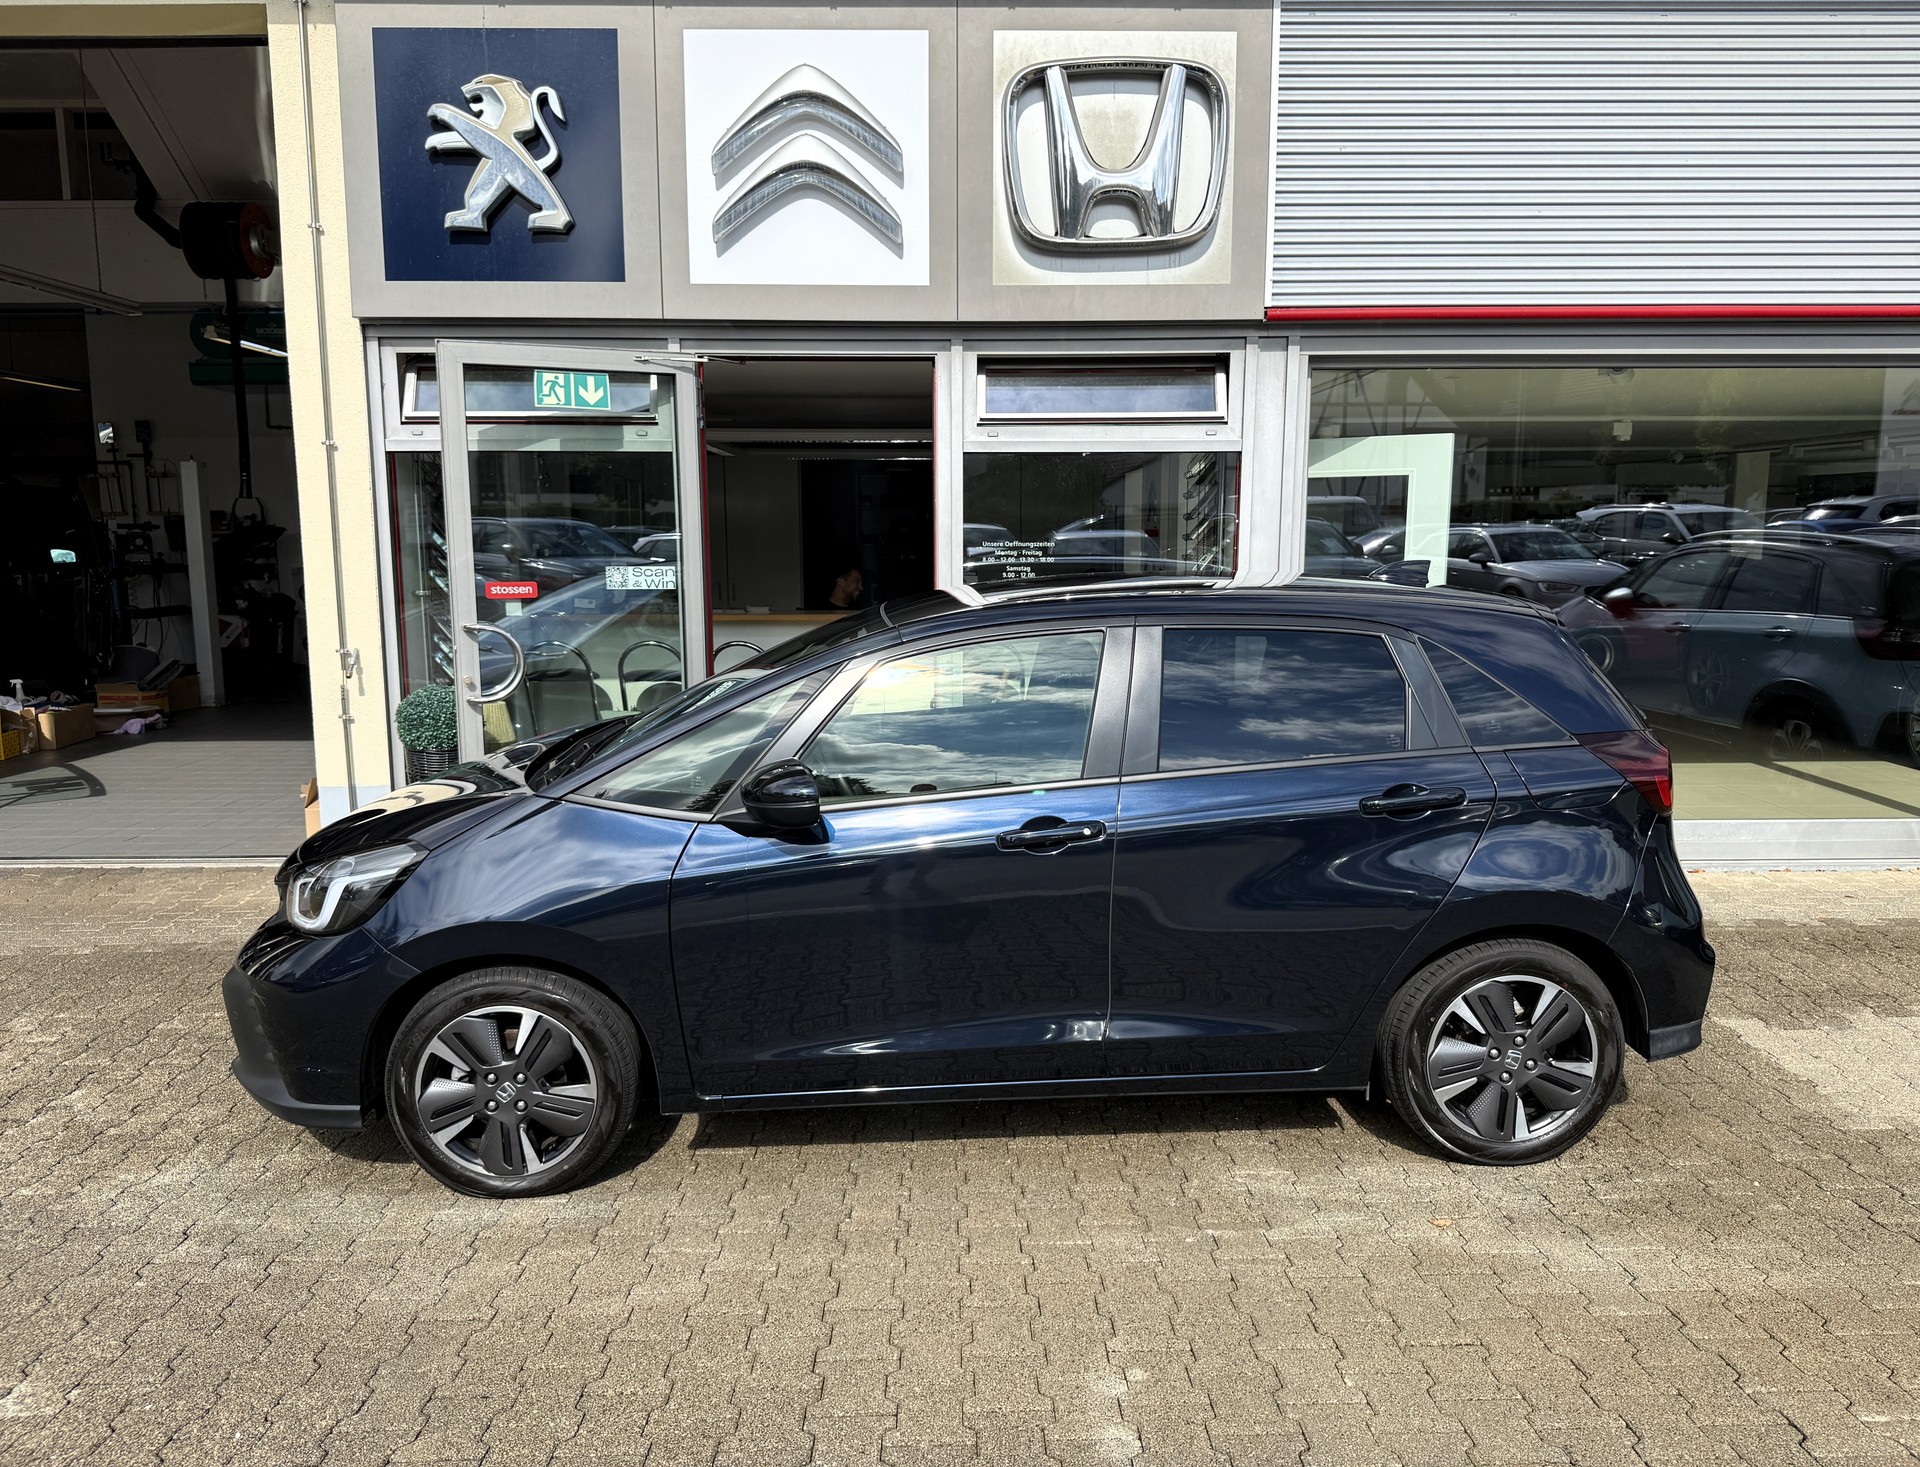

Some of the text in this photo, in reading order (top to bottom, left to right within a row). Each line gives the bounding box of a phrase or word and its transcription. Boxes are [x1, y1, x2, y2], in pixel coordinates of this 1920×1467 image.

[632, 567, 675, 577] Scan
[632, 578, 676, 588] & Win
[490, 585, 533, 594] stossen
